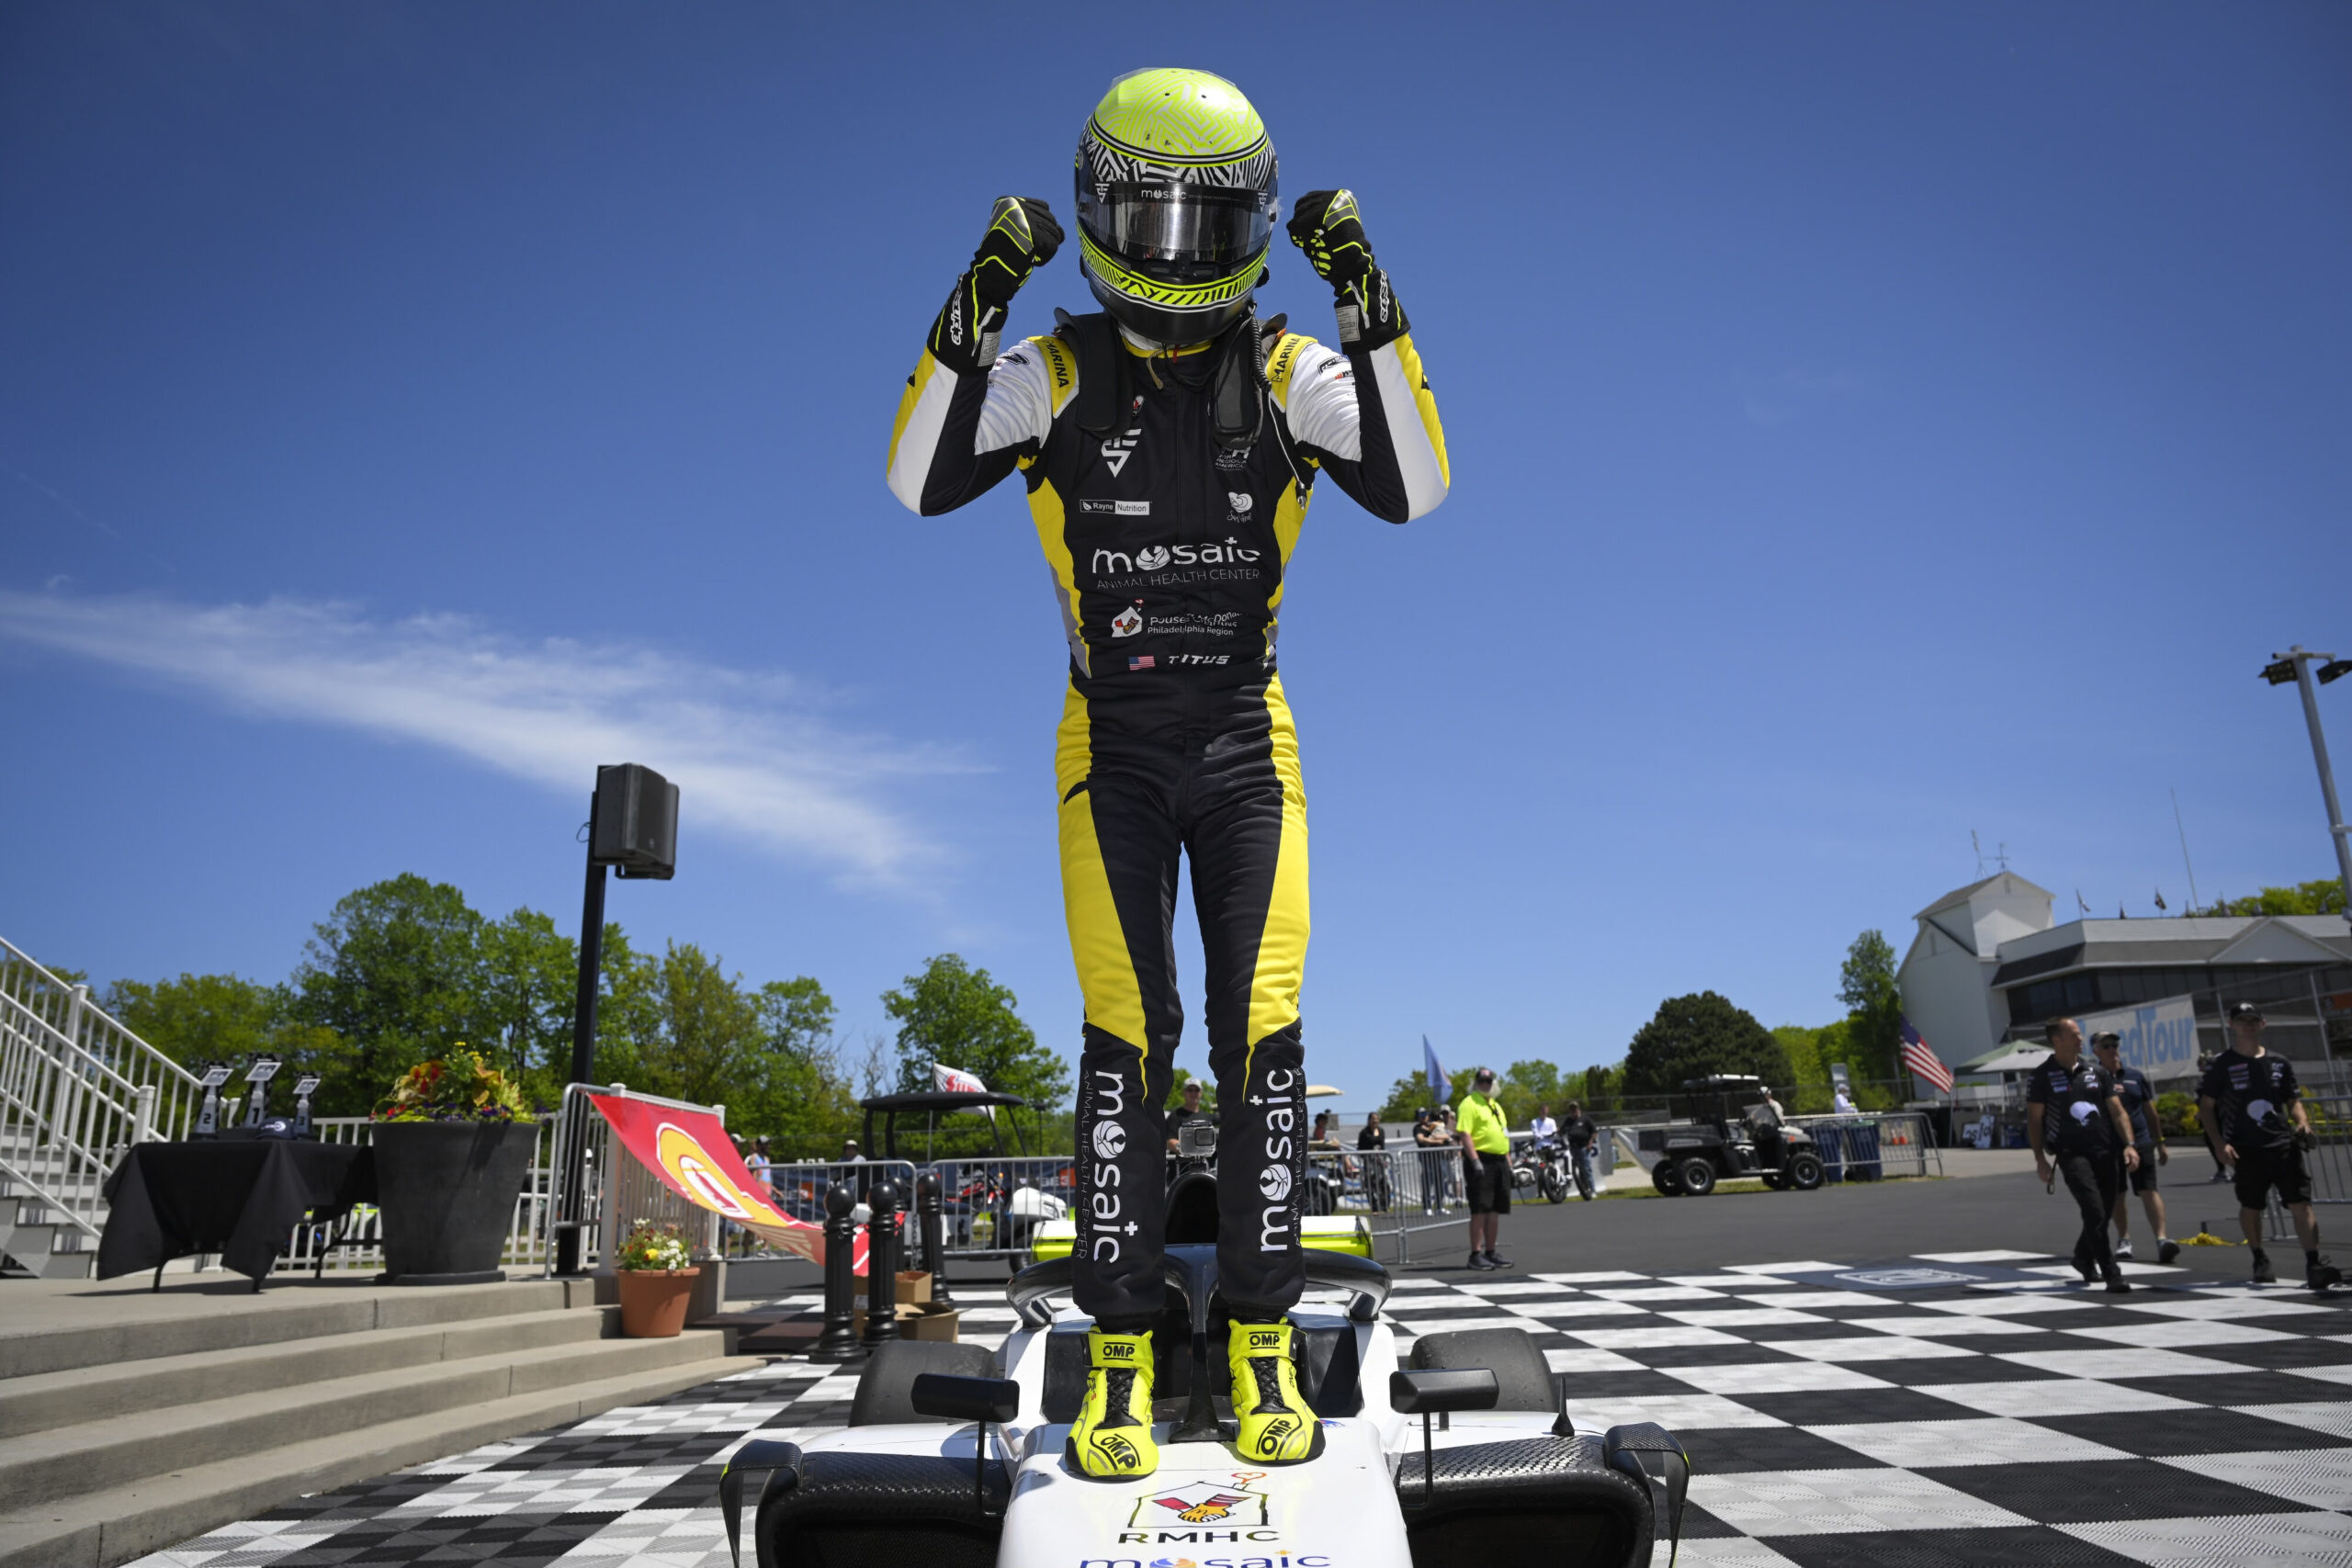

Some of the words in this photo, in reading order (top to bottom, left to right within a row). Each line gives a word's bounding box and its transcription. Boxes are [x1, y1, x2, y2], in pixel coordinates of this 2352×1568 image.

[1271, 337, 1301, 382] MARINA
[1092, 502, 1114, 511] Rayne
[1117, 503, 1147, 513] Nutrition
[1092, 536, 1261, 574] mosaic
[1096, 578, 1148, 589] ANIMAL
[1150, 570, 1207, 586] HEALTH
[1209, 569, 1261, 581] CENTER
[1206, 626, 1234, 637] Region
[1169, 654, 1231, 665] TITUS
[1080, 1068, 1094, 1129] ANIMAL
[1292, 1066, 1306, 1123] CENTER
[203, 1113, 211, 1124] 2
[253, 1108, 260, 1124] 1
[1080, 1133, 1091, 1193] HEALTH
[1092, 1070, 1138, 1264] mosaic
[1250, 1068, 1295, 1252] mosaic
[1295, 1128, 1305, 1185] HEALTH
[1076, 1197, 1091, 1259] CENTER
[1102, 1345, 1135, 1358] OMP
[1250, 1334, 1280, 1347] OMP
[1101, 1437, 1136, 1469] OMP
[1261, 1420, 1292, 1455] OMP
[1118, 1530, 1281, 1544] RMHC
